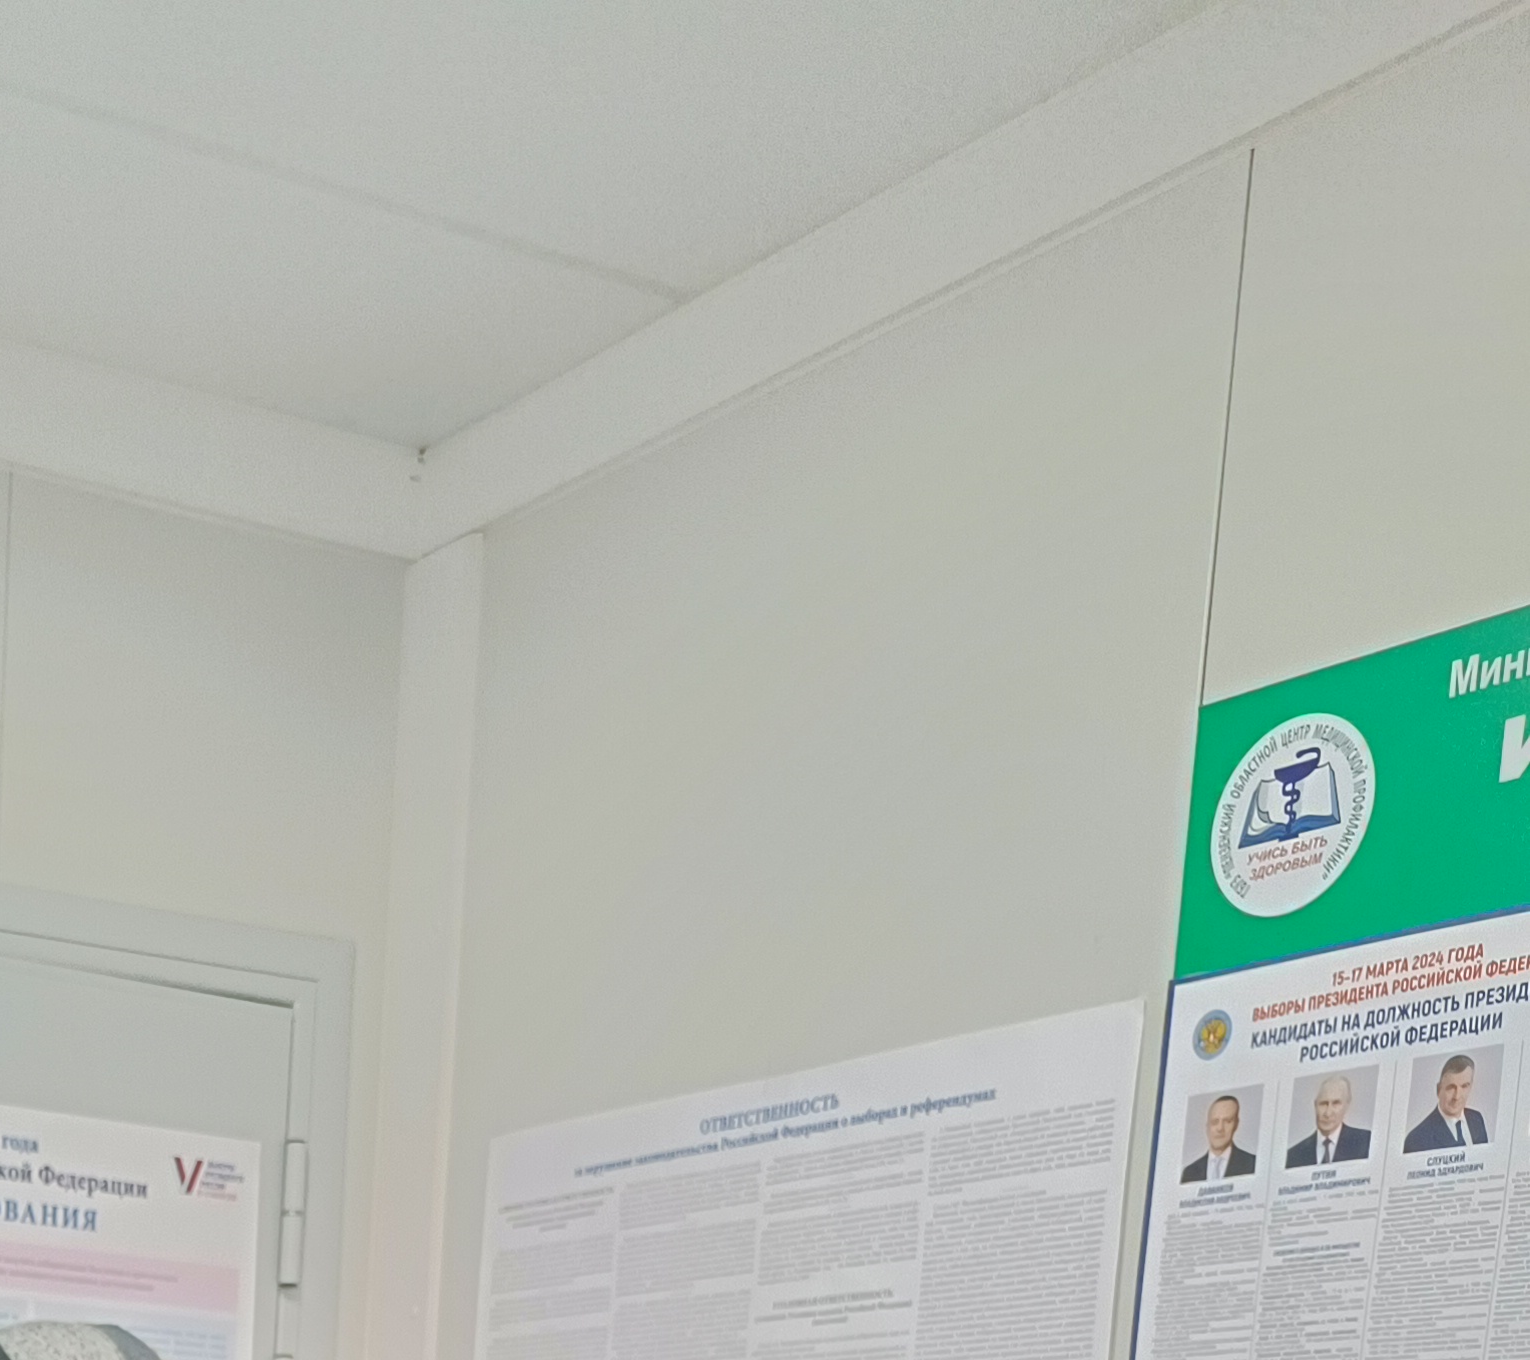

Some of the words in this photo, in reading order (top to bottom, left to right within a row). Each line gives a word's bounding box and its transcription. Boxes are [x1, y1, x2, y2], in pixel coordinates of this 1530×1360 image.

[1449, 648, 1530, 699] Мин
[1231, 736, 1277, 799] ОБЛАСТНОЙ
[1280, 724, 1311, 748] ЦЕНТР
[1312, 723, 1368, 778] МЕДИЦИНСКОЙ
[1247, 848, 1288, 866] УЧИСЬ
[1291, 836, 1328, 854] БЫТЬ
[1249, 853, 1323, 881] ЗДОРОВЫМ
[1365, 958, 1409, 979] МАРТА
[1412, 951, 1444, 970] 2024
[1447, 943, 1484, 965] ГОДА
[1252, 999, 1306, 1022] ВЫБОРЫ
[1308, 984, 1389, 1012] ПРЕЗИДЕНТА
[1392, 961, 1483, 993] РОССИЙСКОЙ
[1251, 1017, 1338, 1049] КАНДИДАТЫ
[1341, 1015, 1360, 1032] НА
[1364, 995, 1460, 1030] ДОЛЖНОСТЬ
[1464, 981, 1530, 1009] ПРЕЗИД
[1300, 1028, 1401, 1063] РОССИЙСКОЙ
[1404, 1012, 1503, 1046] ФЕДЕРАЦИИ
[699, 1093, 840, 1135] ОТВЕТСТВЕННОСТЬ
[720, 1127, 779, 1151] Российской
[781, 1114, 839, 1139] Федерации
[841, 1116, 848, 1127] о
[850, 1106, 898, 1126] выборах
[899, 1105, 908, 1117] и
[910, 1088, 996, 1119] референдумах
[1, 1135, 39, 1155] года
[1426, 1151, 1466, 1166] СЛУЦКИЙ
[38, 1165, 149, 1200] Федерации
[1437, 1162, 1484, 1177] ЭДУАРДОВИЧ
